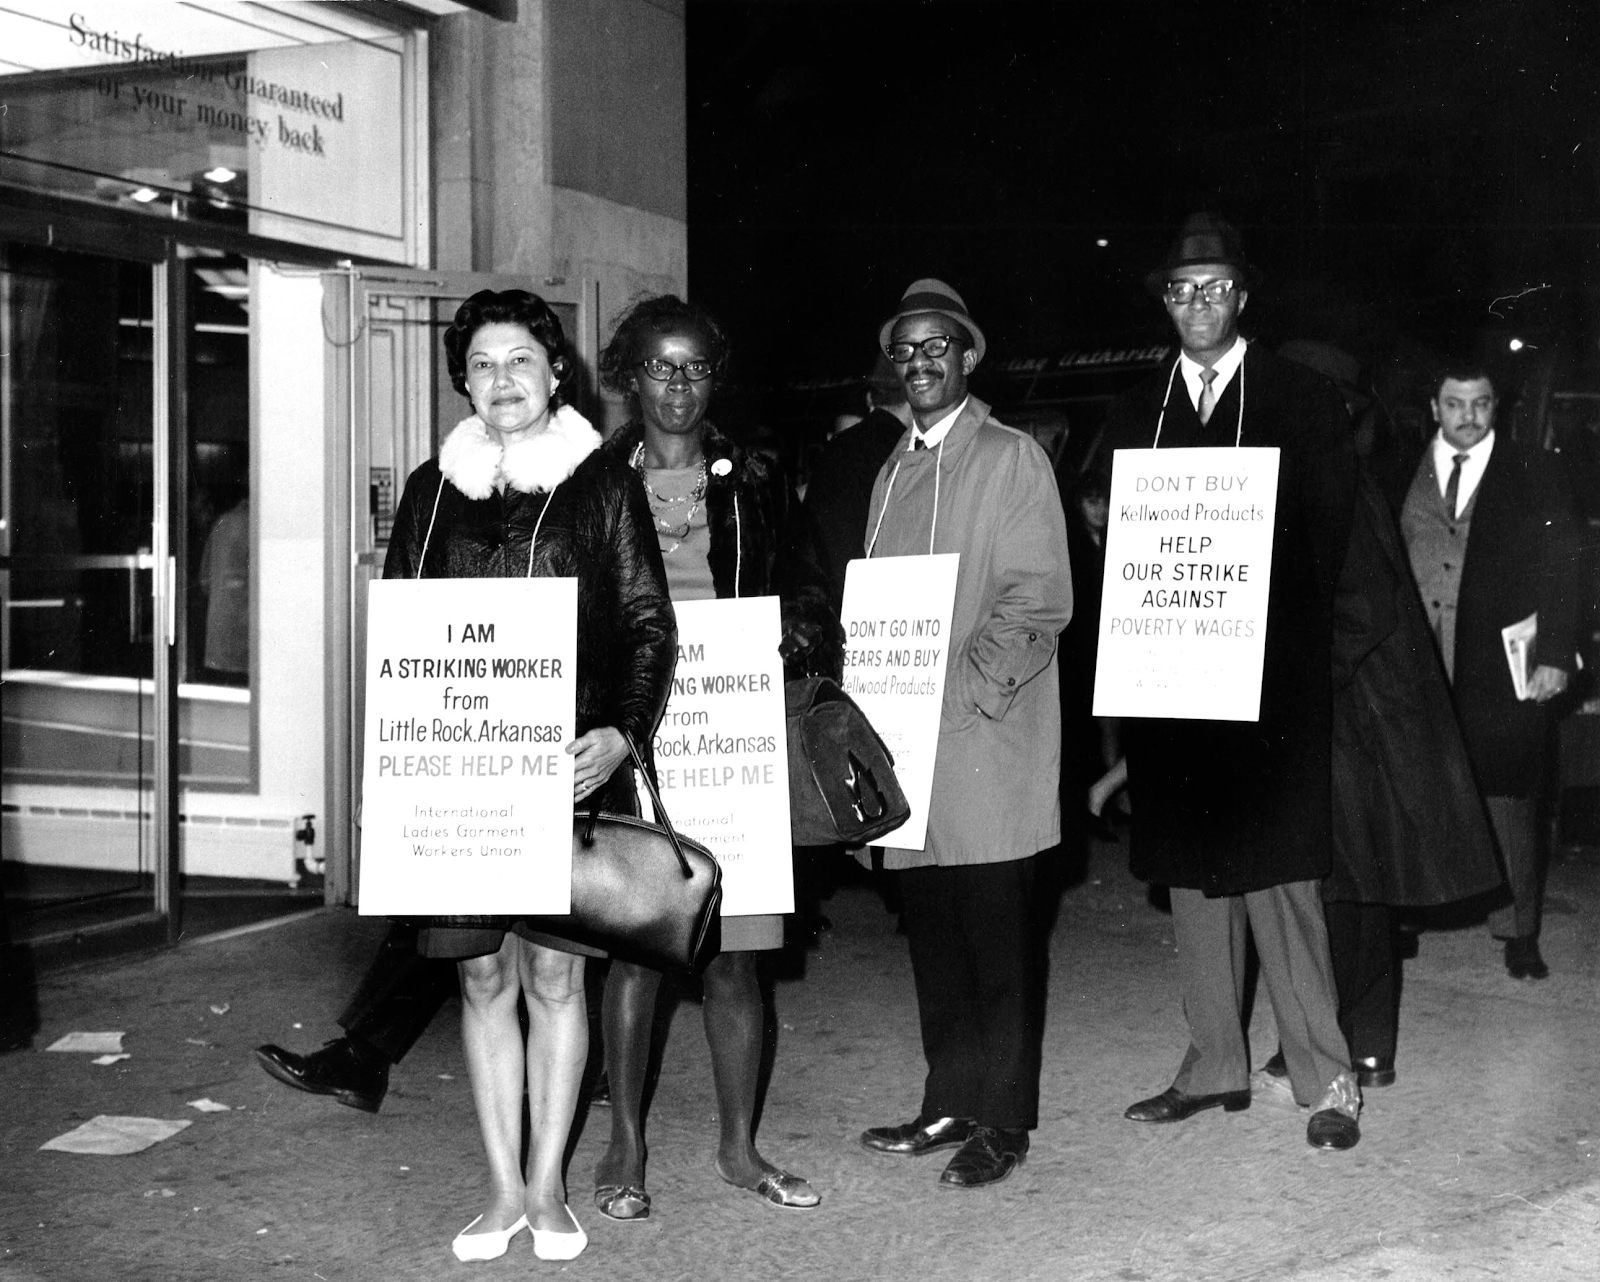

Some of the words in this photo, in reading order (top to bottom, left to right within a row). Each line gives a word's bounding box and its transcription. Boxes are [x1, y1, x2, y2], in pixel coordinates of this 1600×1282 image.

[69, 12, 214, 82] Satisfaction
[223, 61, 343, 122] Guaranteed
[97, 77, 121, 100] or
[133, 85, 187, 115] your
[197, 104, 268, 152] money
[278, 114, 325, 158] back
[1206, 476, 1249, 492] BUY
[1121, 504, 1190, 521] Kellwood
[1195, 503, 1264, 521] Products
[1160, 536, 1213, 553] HELP
[1122, 563, 1163, 581] OUR
[1172, 563, 1250, 582] STRIKE
[1141, 589, 1228, 609] AGAINST
[447, 624, 453, 643] I
[461, 623, 495, 643] AM
[890, 619, 908, 638] GO
[912, 619, 941, 637] INTO
[1111, 618, 1187, 636] POVERTY
[1195, 619, 1255, 637] WAGES
[677, 644, 705, 663] AM
[843, 650, 882, 667] SEARS
[885, 650, 911, 667] AND
[914, 649, 941, 667] BUY
[379, 658, 393, 678] A
[398, 658, 488, 679] STRIKING
[492, 658, 563, 679] WORKER
[701, 673, 771, 695] WORKER
[890, 675, 936, 695] Products
[443, 686, 489, 710] from
[379, 717, 428, 742] Little
[478, 719, 563, 743] Arkansas
[697, 733, 776, 756] Arkansas
[379, 755, 452, 777] PLEASE
[461, 755, 513, 777] HELP
[522, 755, 558, 776] ME
[683, 766, 735, 788] HELP
[742, 764, 774, 785] ME
[415, 804, 513, 818] International
[674, 813, 734, 827] national
[403, 824, 449, 838] Ladies
[457, 824, 525, 838] Garment
[688, 832, 745, 844] arment
[412, 844, 473, 857] Workers
[481, 845, 522, 857] Union
[714, 852, 744, 862] nion
